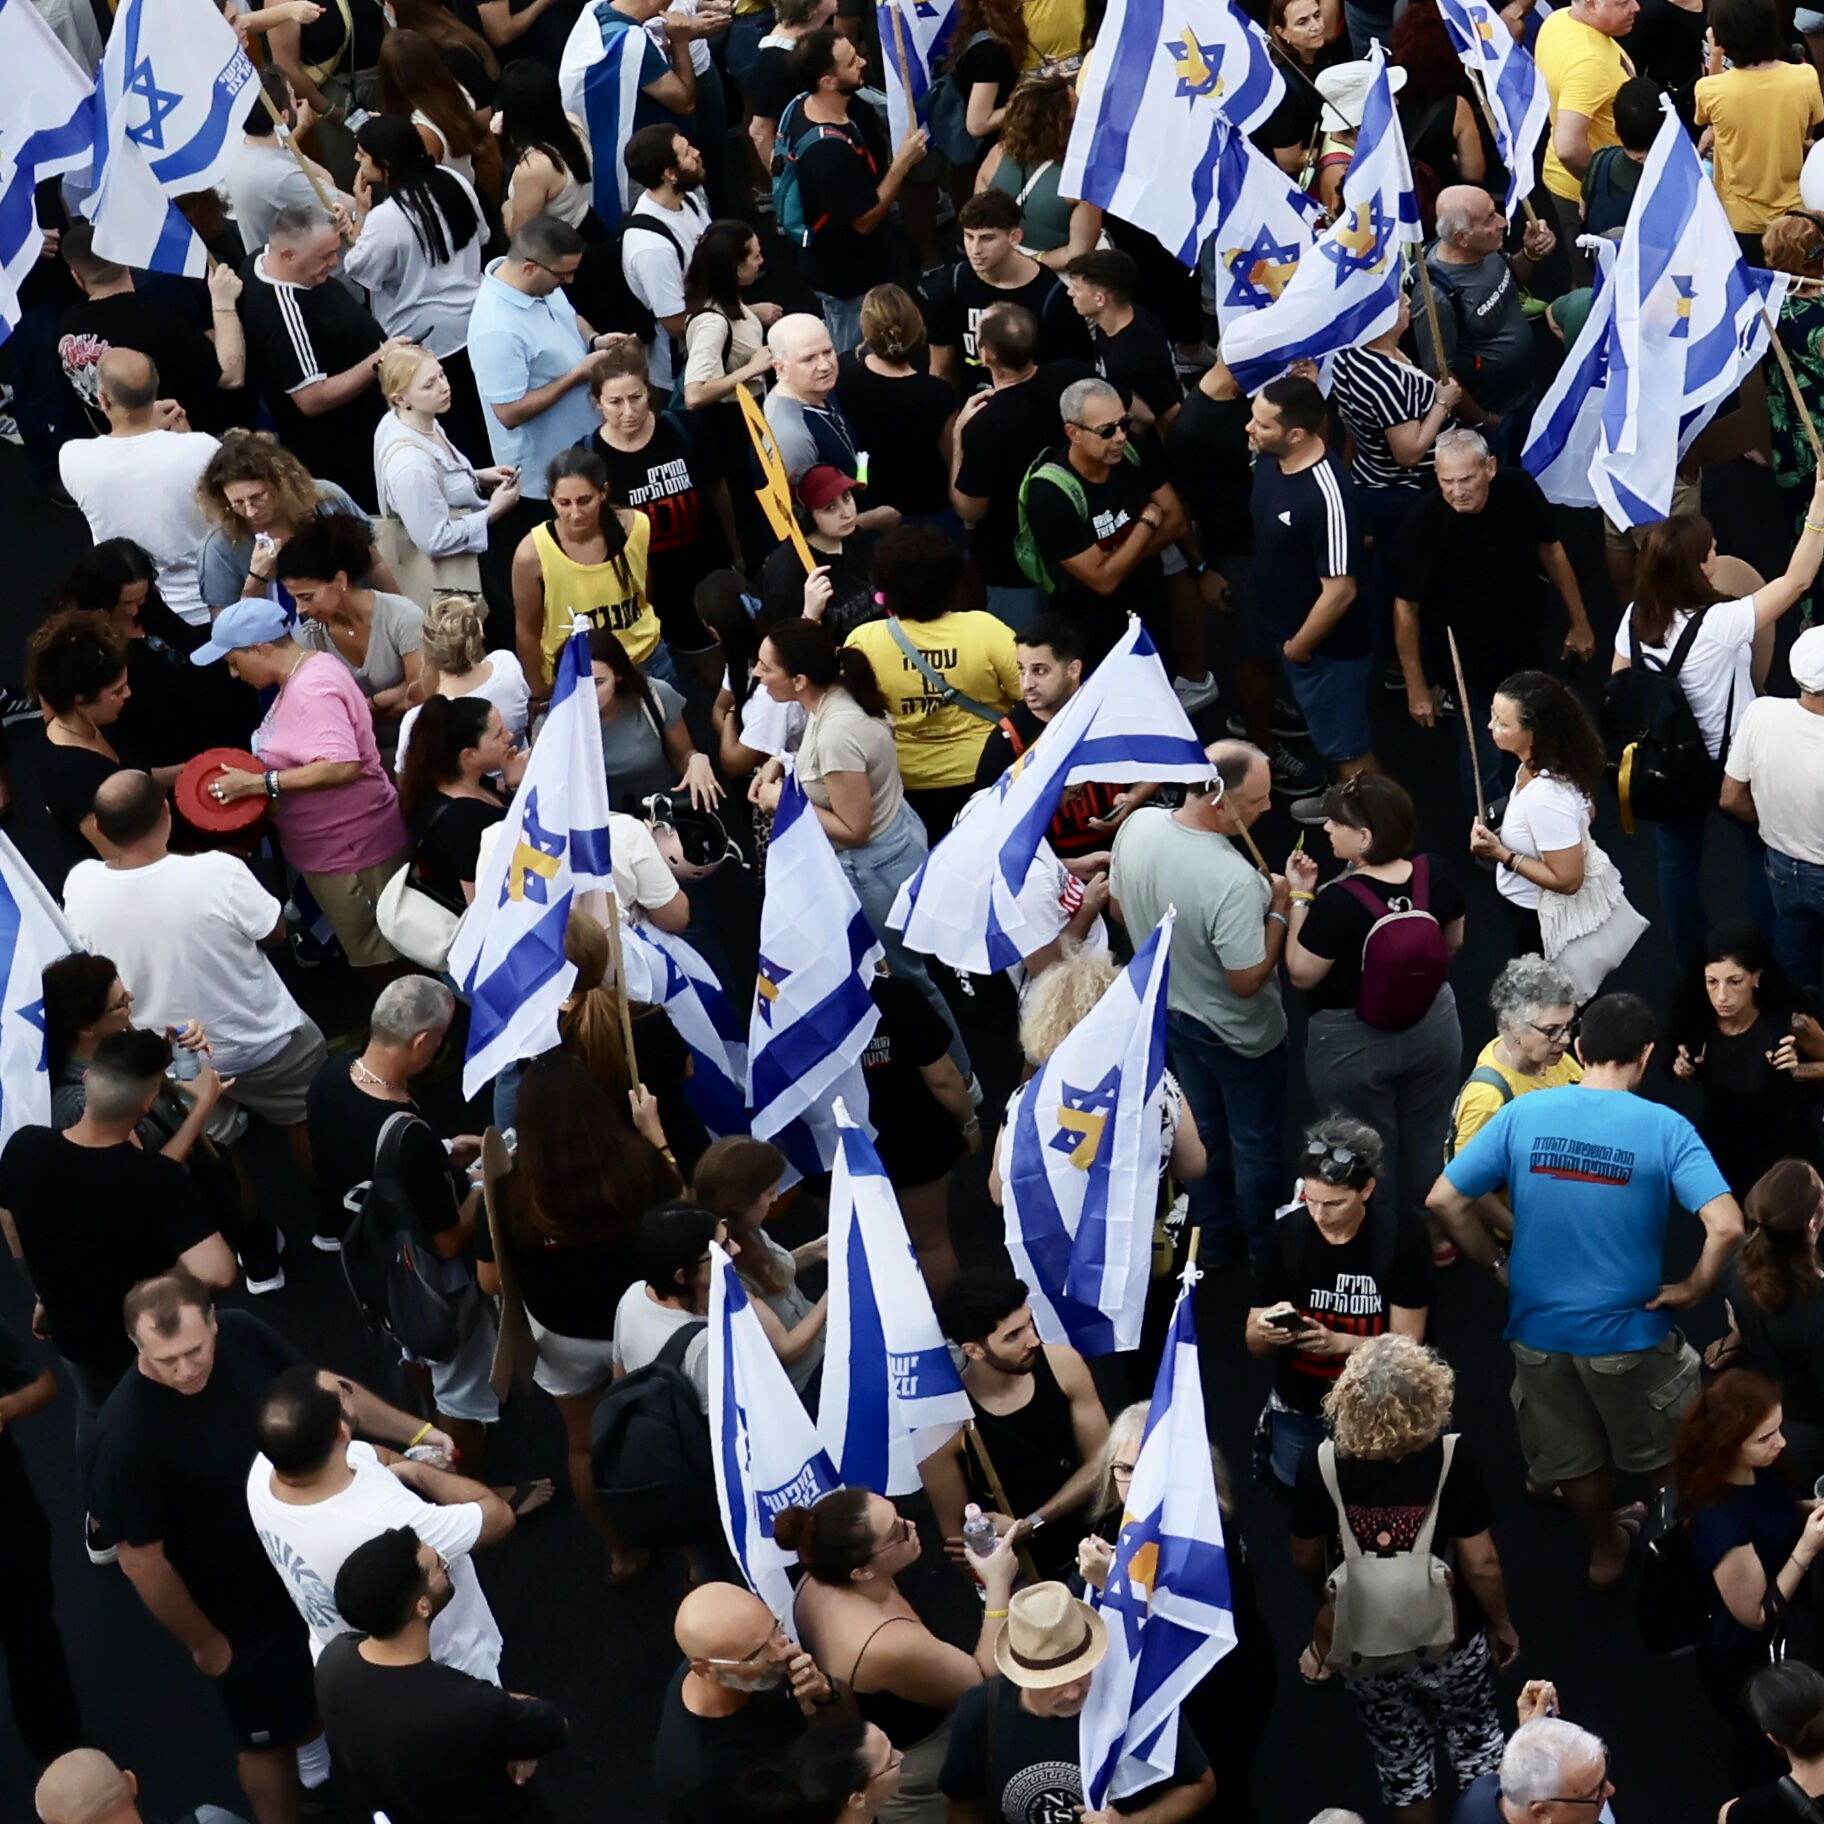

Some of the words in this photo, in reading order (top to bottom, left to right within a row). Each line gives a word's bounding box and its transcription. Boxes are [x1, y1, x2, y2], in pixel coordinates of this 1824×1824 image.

[1476, 290, 1500, 316] GRAND
[646, 458, 688, 484] מחזירים
[628, 483, 665, 507] הביתה
[667, 474, 694, 496] אותם
[1310, 1288, 1353, 1312] הביתה
